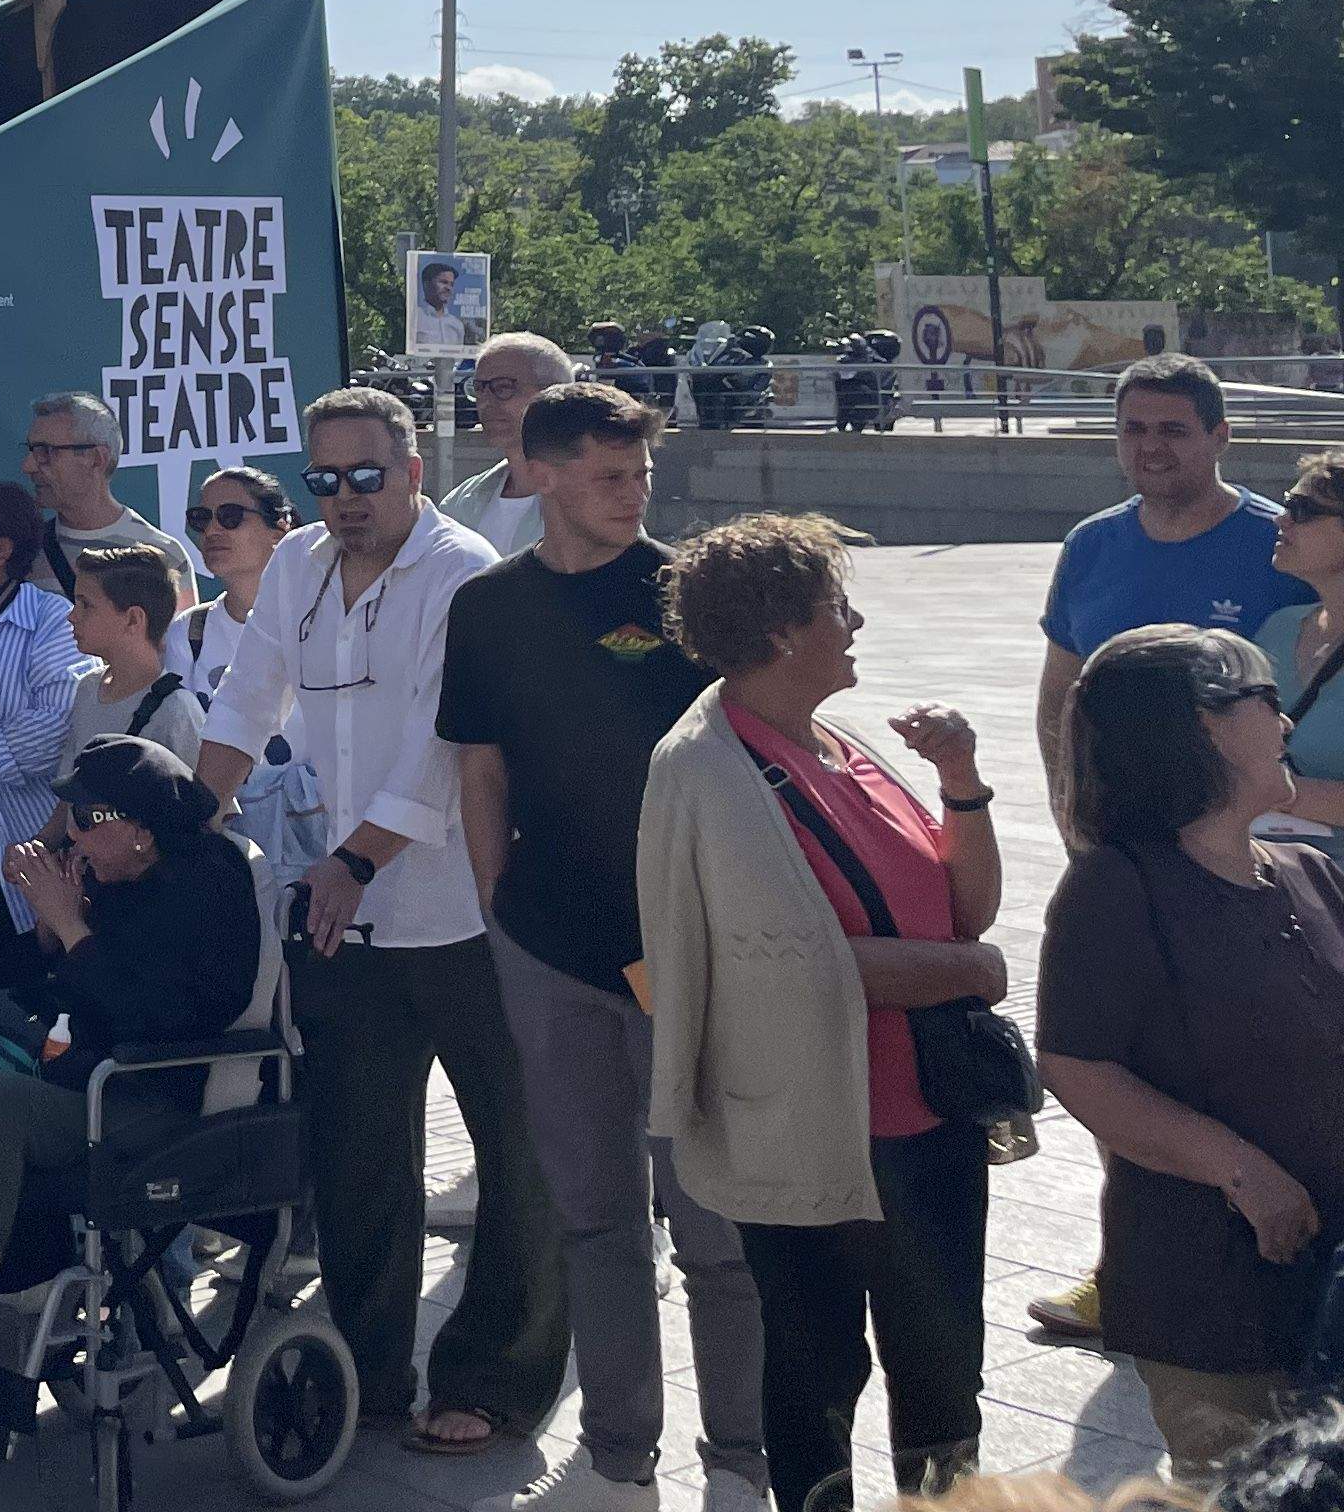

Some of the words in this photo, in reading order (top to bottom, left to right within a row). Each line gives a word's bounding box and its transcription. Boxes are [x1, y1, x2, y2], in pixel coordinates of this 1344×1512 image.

[105, 207, 274, 284] TEATRE
[130, 289, 266, 368] SENSE
[110, 369, 287, 454] TEATRE
